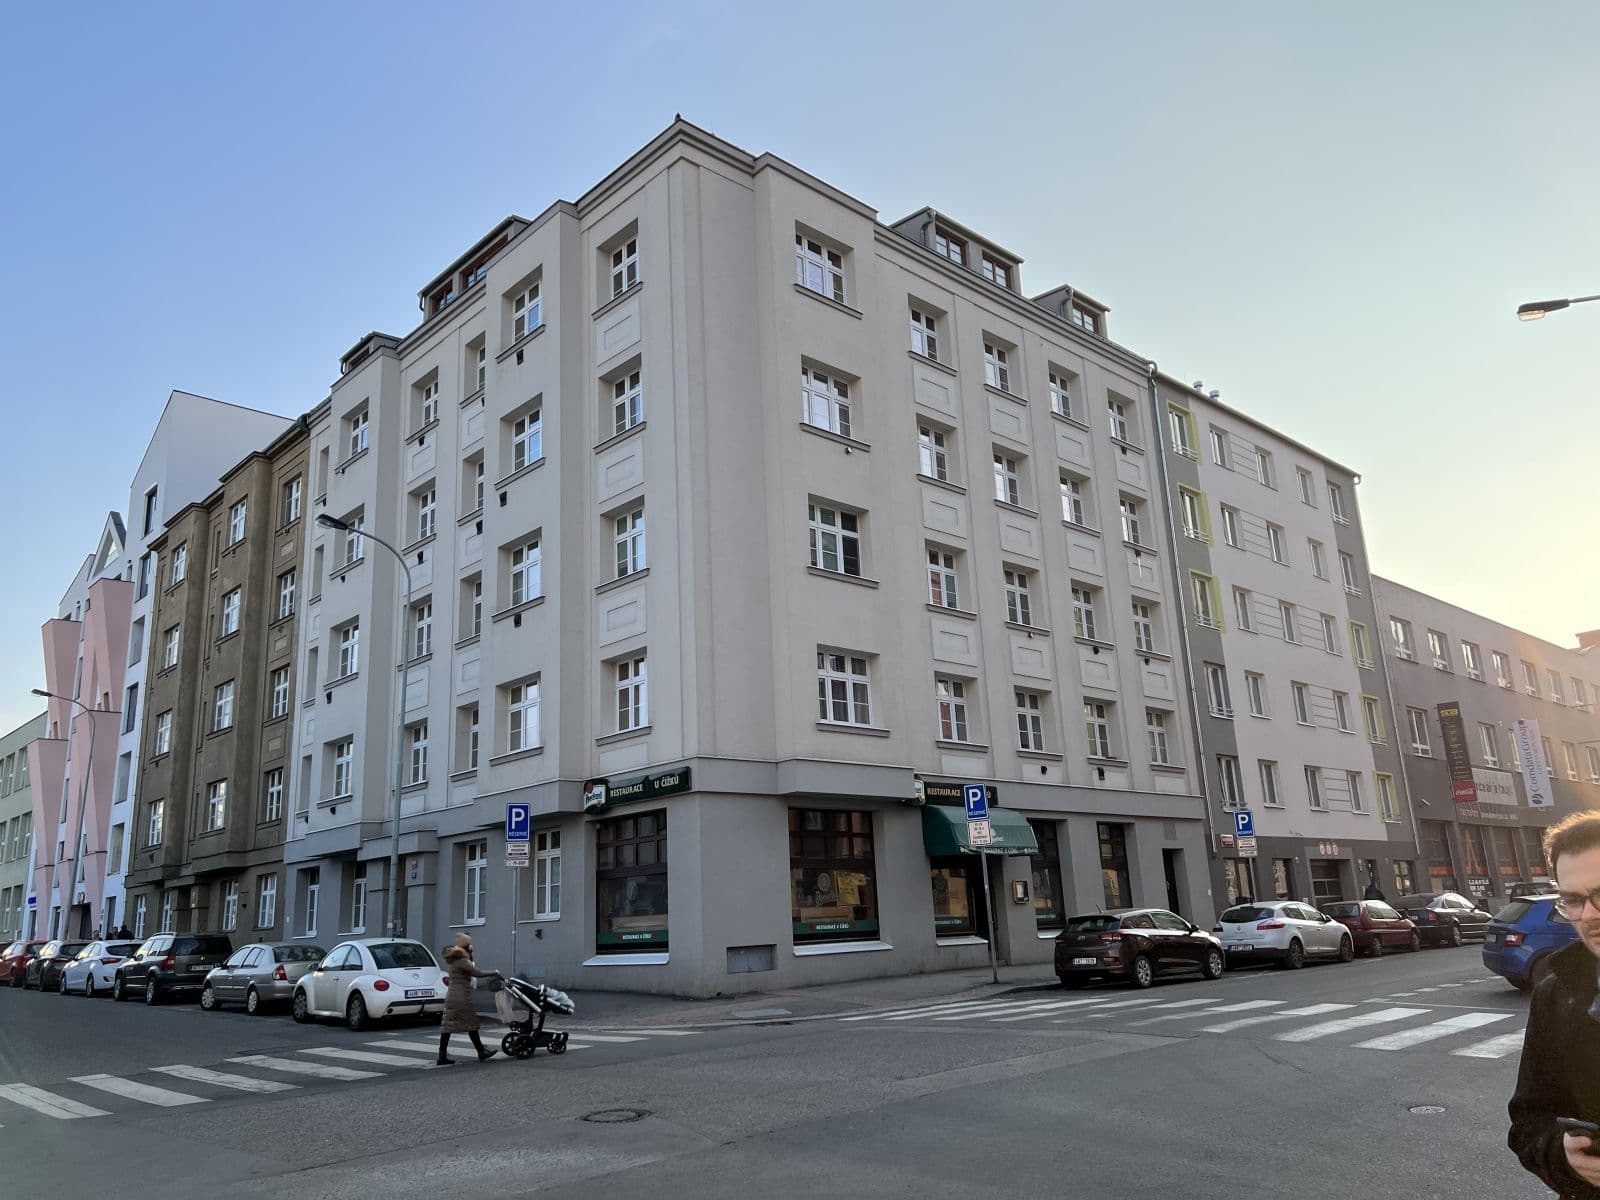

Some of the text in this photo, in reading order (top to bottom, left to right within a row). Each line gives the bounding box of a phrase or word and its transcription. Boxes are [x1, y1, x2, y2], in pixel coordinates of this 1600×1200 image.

[610, 784, 643, 797] RESTAURACE
[654, 780, 660, 789] U
[927, 787, 961, 797] RESTAURACE
[968, 788, 981, 809] P
[511, 808, 525, 830] P
[1237, 814, 1249, 830] P
